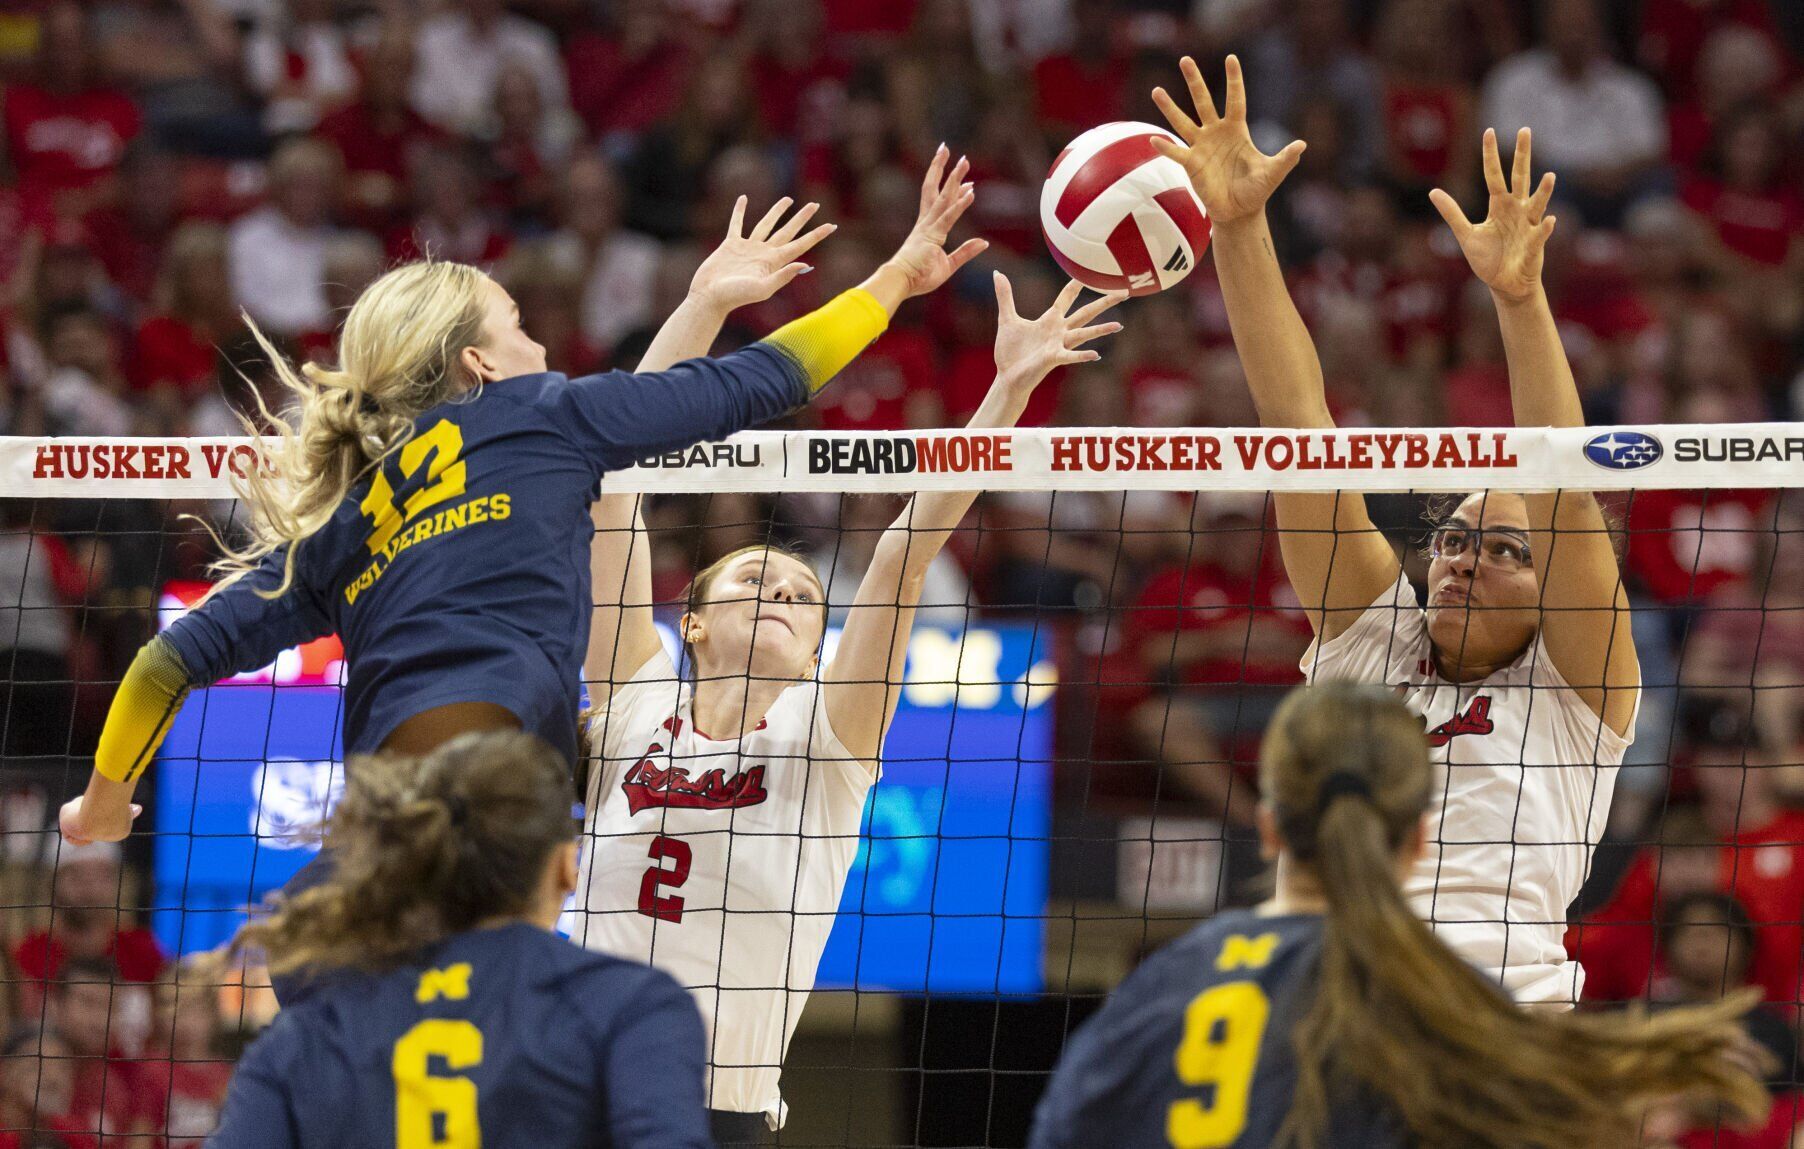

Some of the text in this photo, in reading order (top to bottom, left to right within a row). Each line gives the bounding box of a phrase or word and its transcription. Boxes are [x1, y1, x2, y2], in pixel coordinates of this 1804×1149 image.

[1128, 271, 1156, 290] N
[32, 444, 284, 480] HUSKER VO
[628, 443, 760, 469] BARU
[808, 435, 1013, 475] BEARDMORE
[1050, 433, 1518, 472] HUSKER VOLLEYBALL
[360, 418, 466, 556] 12
[637, 835, 692, 924] 2
[392, 1018, 484, 1149] 6
[1165, 980, 1270, 1149] 9
